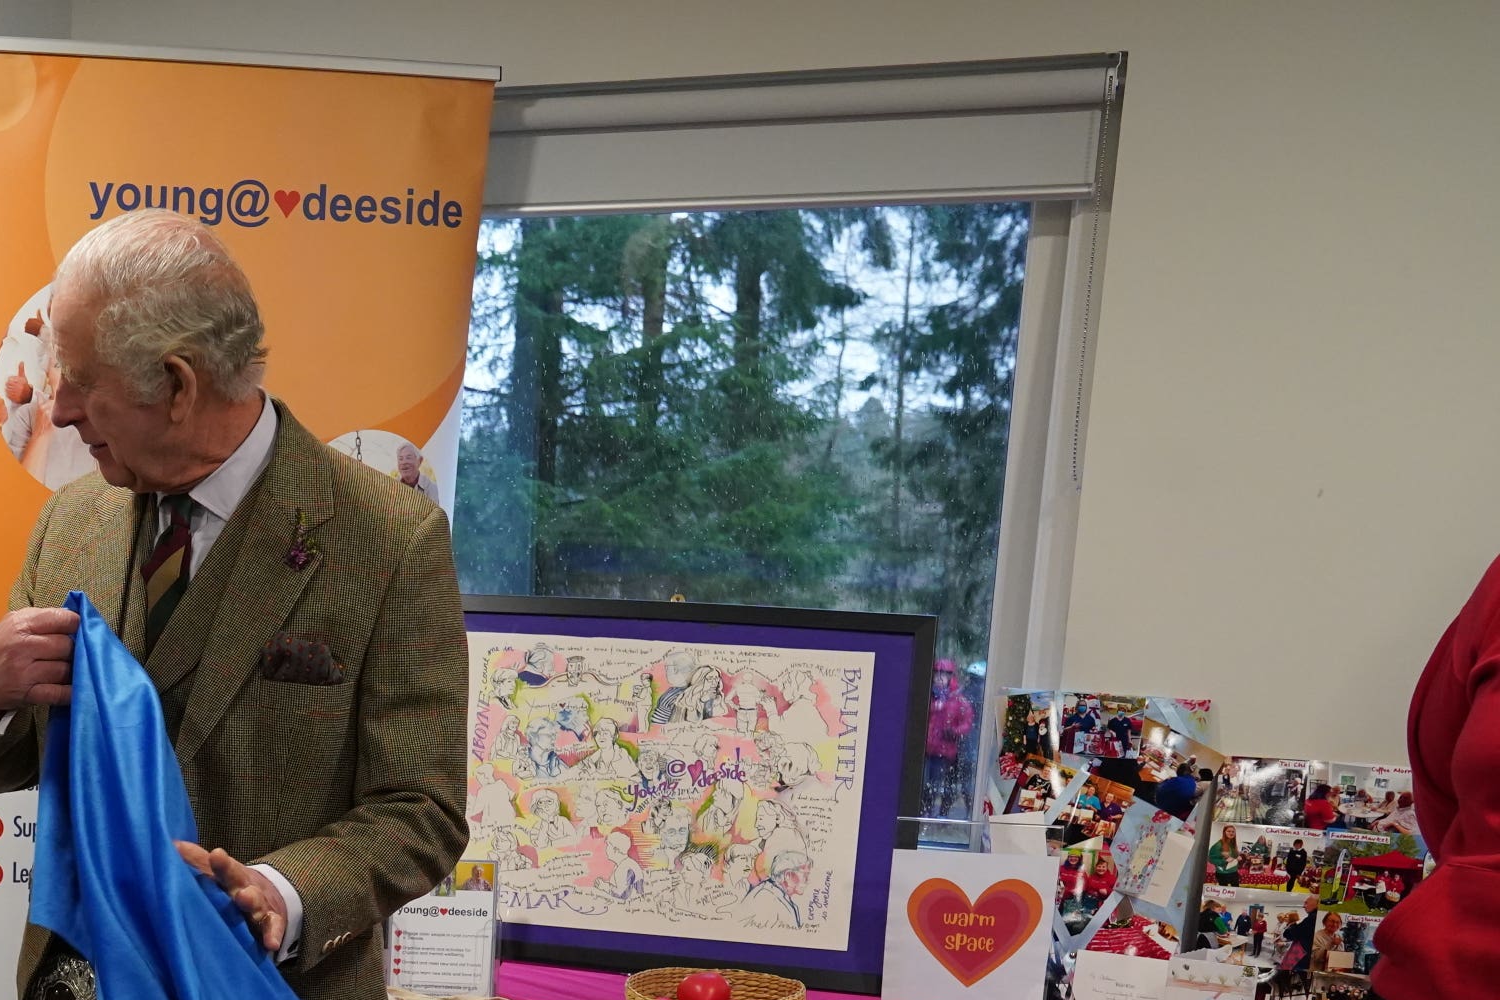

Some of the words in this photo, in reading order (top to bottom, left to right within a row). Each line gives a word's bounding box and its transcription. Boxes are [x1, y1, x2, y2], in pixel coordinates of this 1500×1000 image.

[302, 184, 464, 229] deeside
[471, 690, 491, 763] ABOYNE
[1371, 766, 1390, 776] Coffee
[12, 861, 30, 884] Le
[1205, 886, 1221, 896] Clay
[1221, 887, 1236, 897] Day
[448, 906, 488, 917] deeside
[943, 911, 995, 927] warm
[943, 932, 995, 953] space
